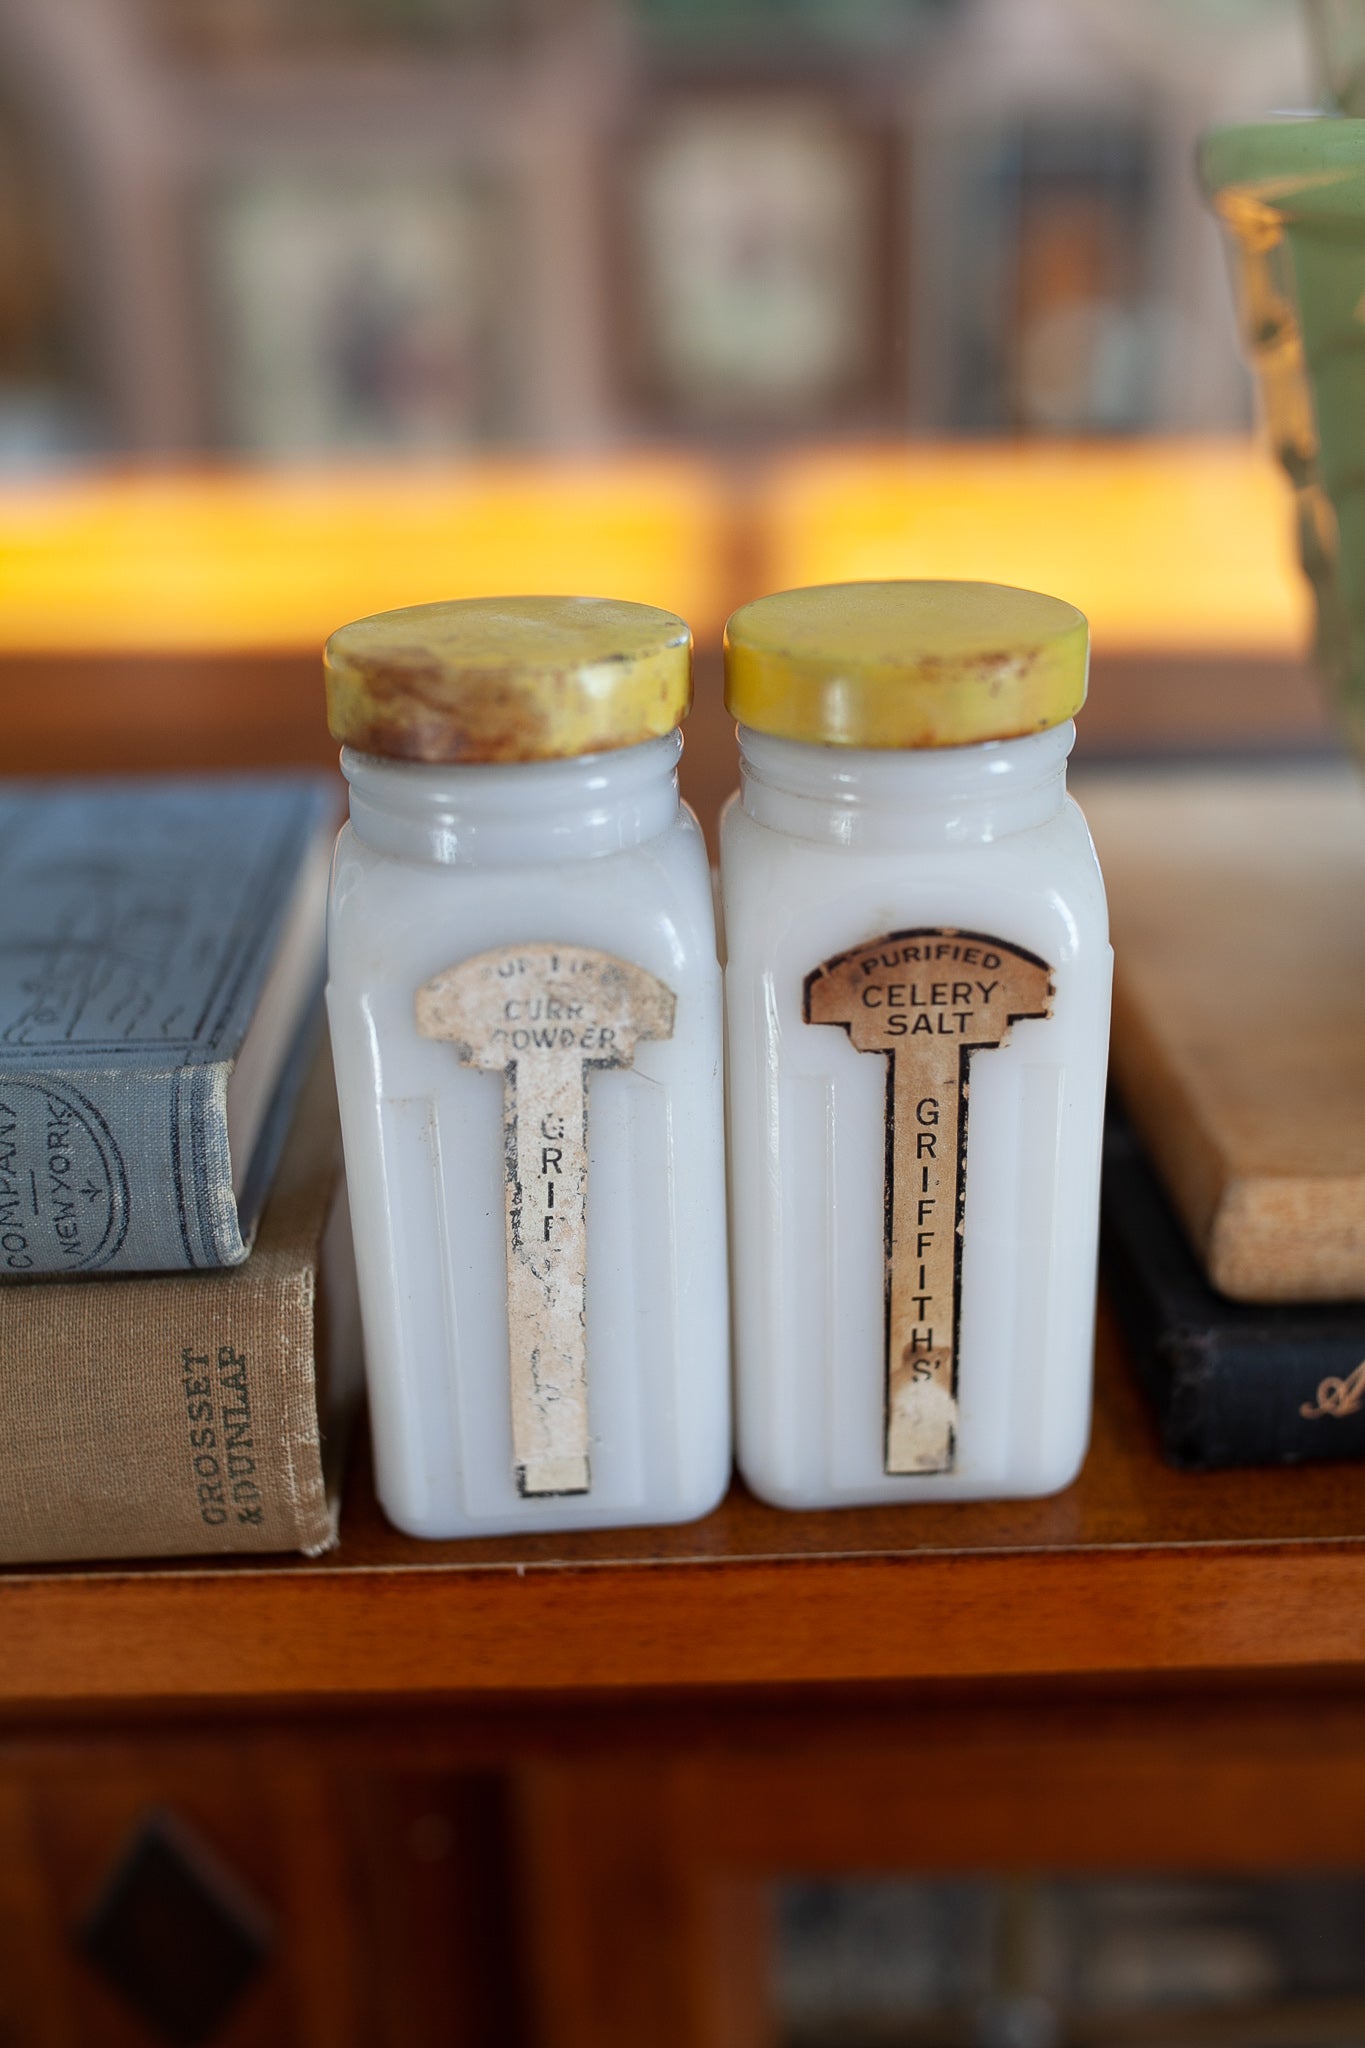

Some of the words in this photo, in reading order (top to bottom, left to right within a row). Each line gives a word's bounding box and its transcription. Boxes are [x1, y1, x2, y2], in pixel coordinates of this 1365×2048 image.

[861, 944, 1003, 976] PURIFIED
[861, 981, 999, 1008] CELERY
[884, 1012, 974, 1035] SALT
[53, 1200, 84, 1256] NEW
[182, 1347, 227, 1525] GROSSET
